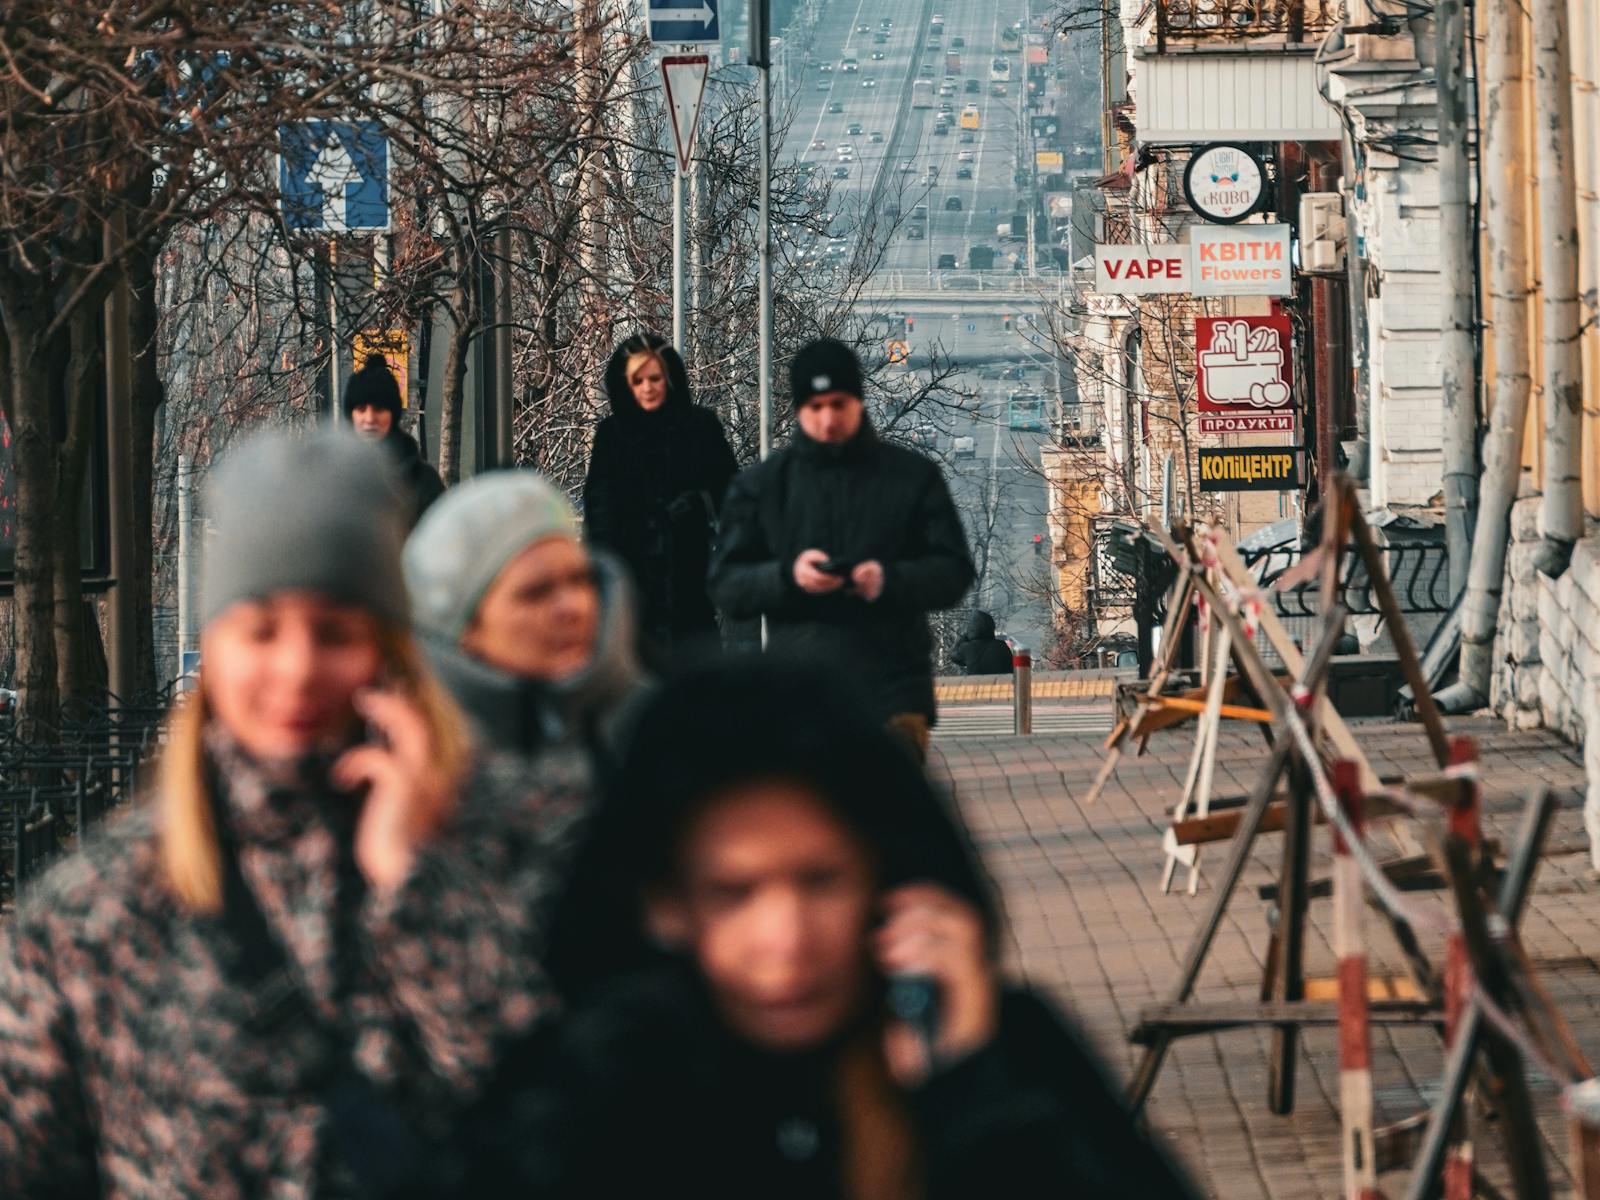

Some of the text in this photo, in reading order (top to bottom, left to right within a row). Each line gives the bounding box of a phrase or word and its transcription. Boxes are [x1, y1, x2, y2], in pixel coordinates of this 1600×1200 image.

[1200, 241, 1282, 261] КВІТИ
[1104, 259, 1182, 280] VAPE
[1201, 265, 1282, 281] Flowers
[1206, 418, 1289, 431] ПРОДУКТИ
